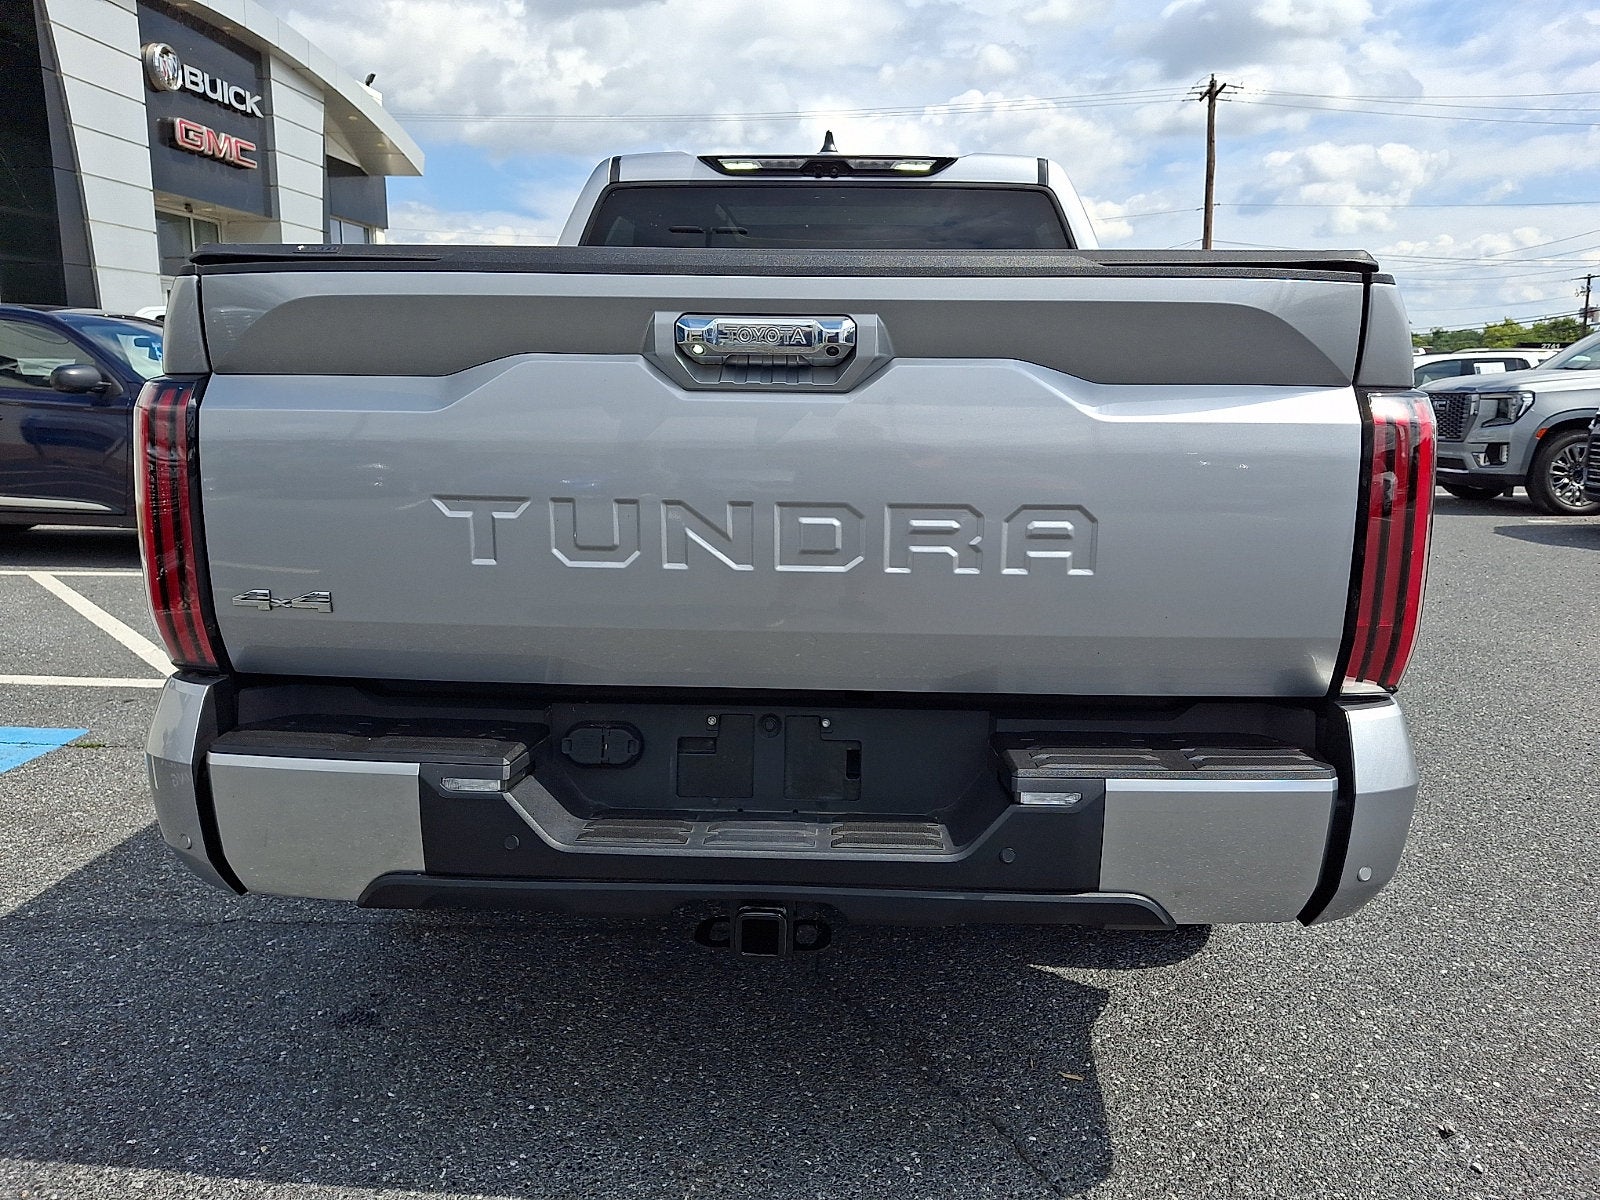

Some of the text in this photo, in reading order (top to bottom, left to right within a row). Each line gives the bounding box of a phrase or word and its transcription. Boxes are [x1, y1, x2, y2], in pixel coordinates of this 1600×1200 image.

[182, 63, 264, 118] BUICK
[174, 117, 257, 168] GMC
[724, 325, 807, 345] TOYOTA
[431, 493, 1099, 576] TUNDRA
